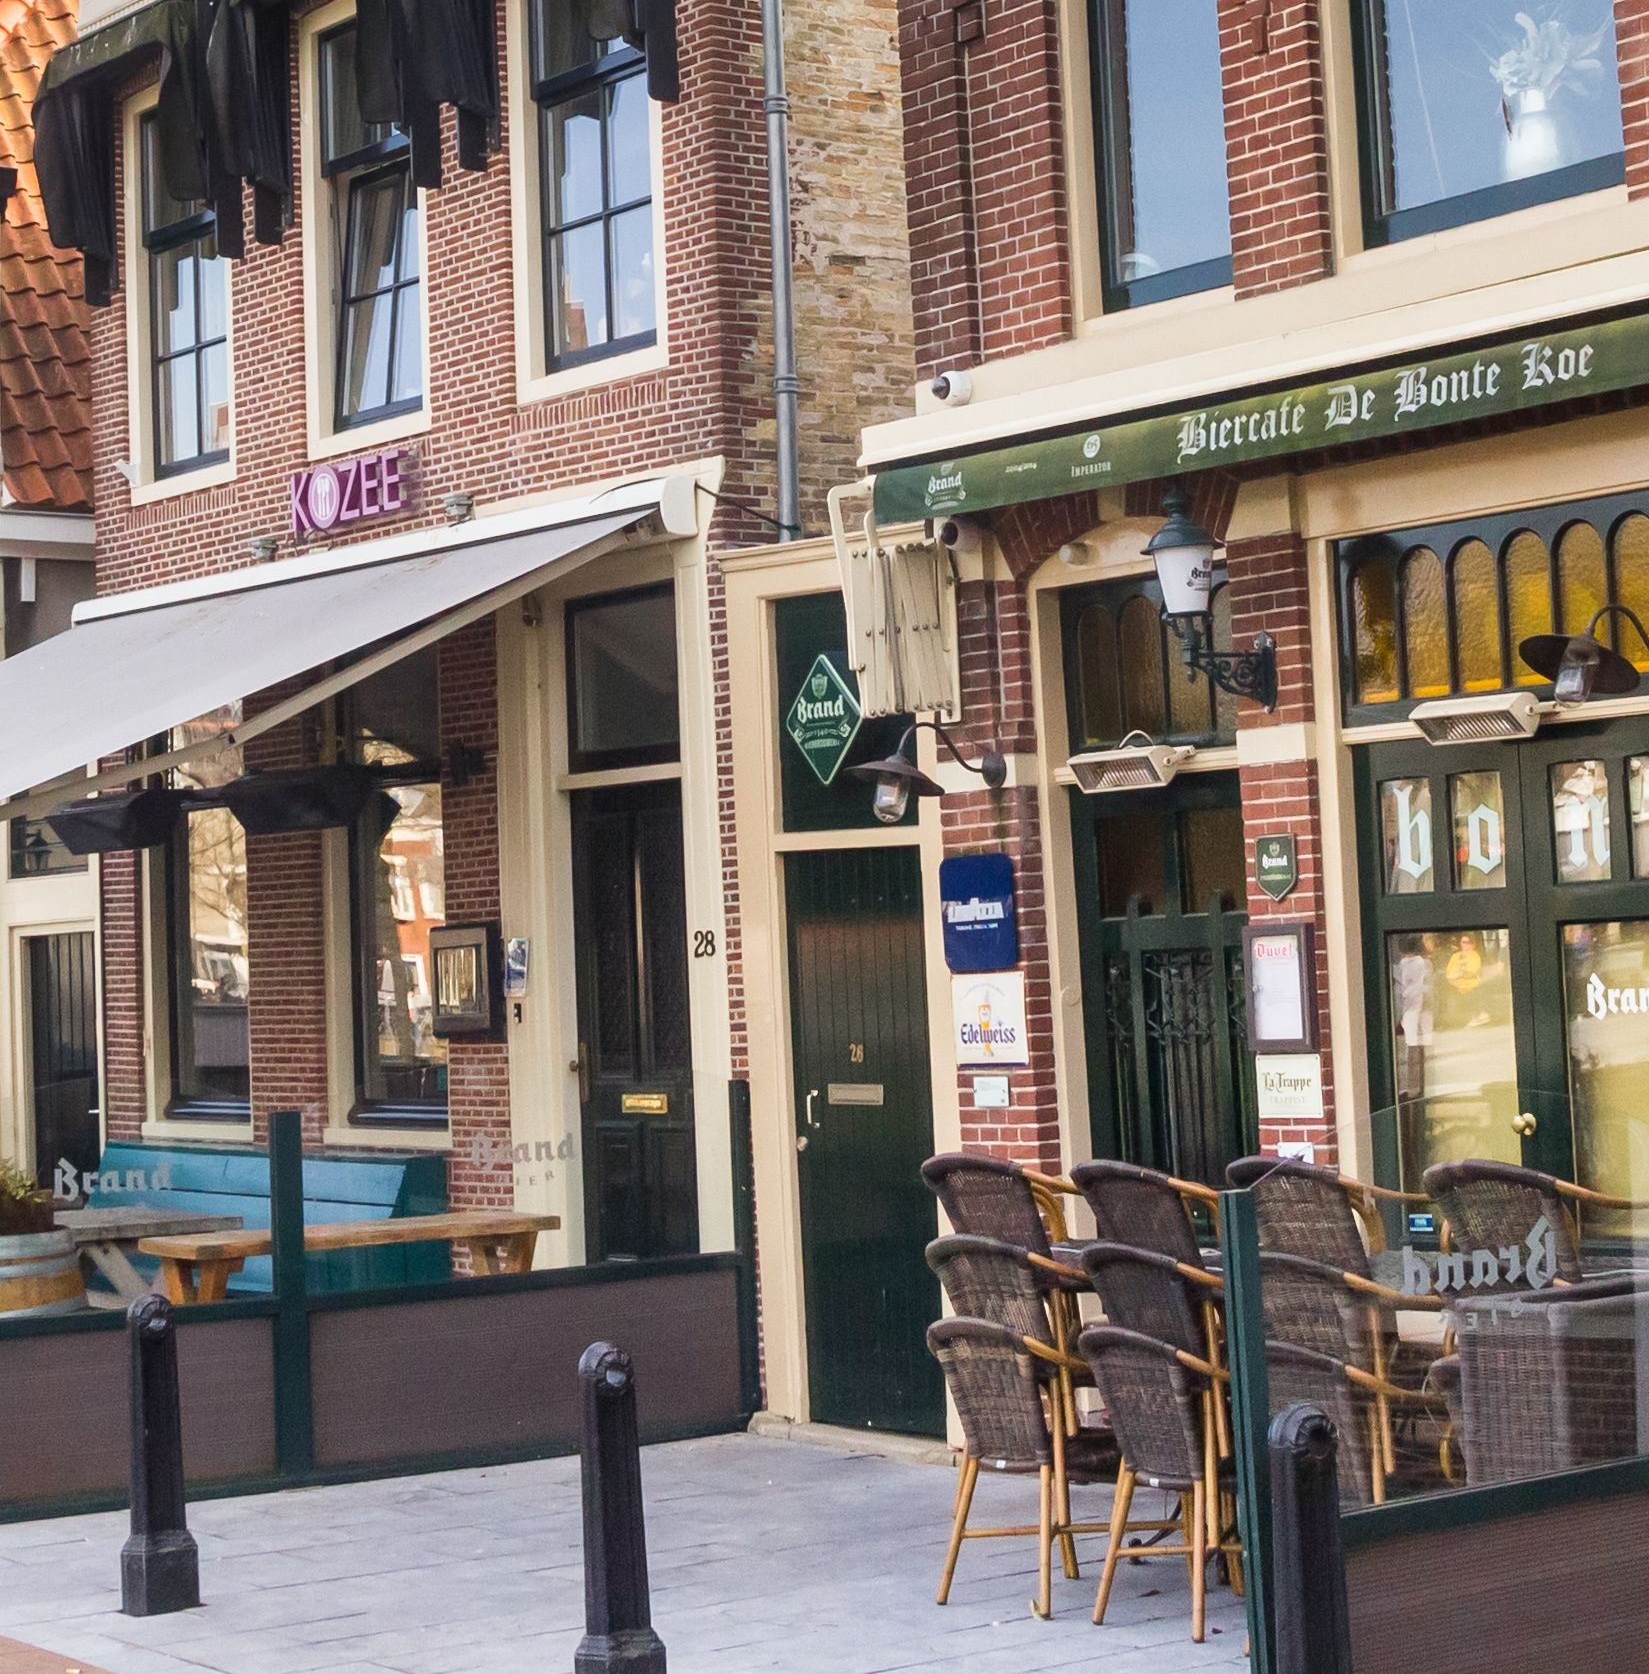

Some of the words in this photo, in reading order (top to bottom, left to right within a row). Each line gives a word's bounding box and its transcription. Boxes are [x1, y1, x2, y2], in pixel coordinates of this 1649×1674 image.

[1324, 384, 1376, 431] De
[1393, 360, 1502, 422] Bonte
[1521, 342, 1594, 391] Koe
[291, 449, 401, 534] KOZEE
[928, 472, 962, 494] Brand
[797, 696, 845, 724] Brand
[1262, 854, 1288, 869] Brand
[694, 930, 716, 958] 28
[1257, 943, 1293, 958] Duvel
[960, 1023, 1016, 1045] Edelweiss
[1262, 1072, 1274, 1092] La
[1275, 1071, 1312, 1093] Trappe
[53, 1157, 172, 1202] Brand
